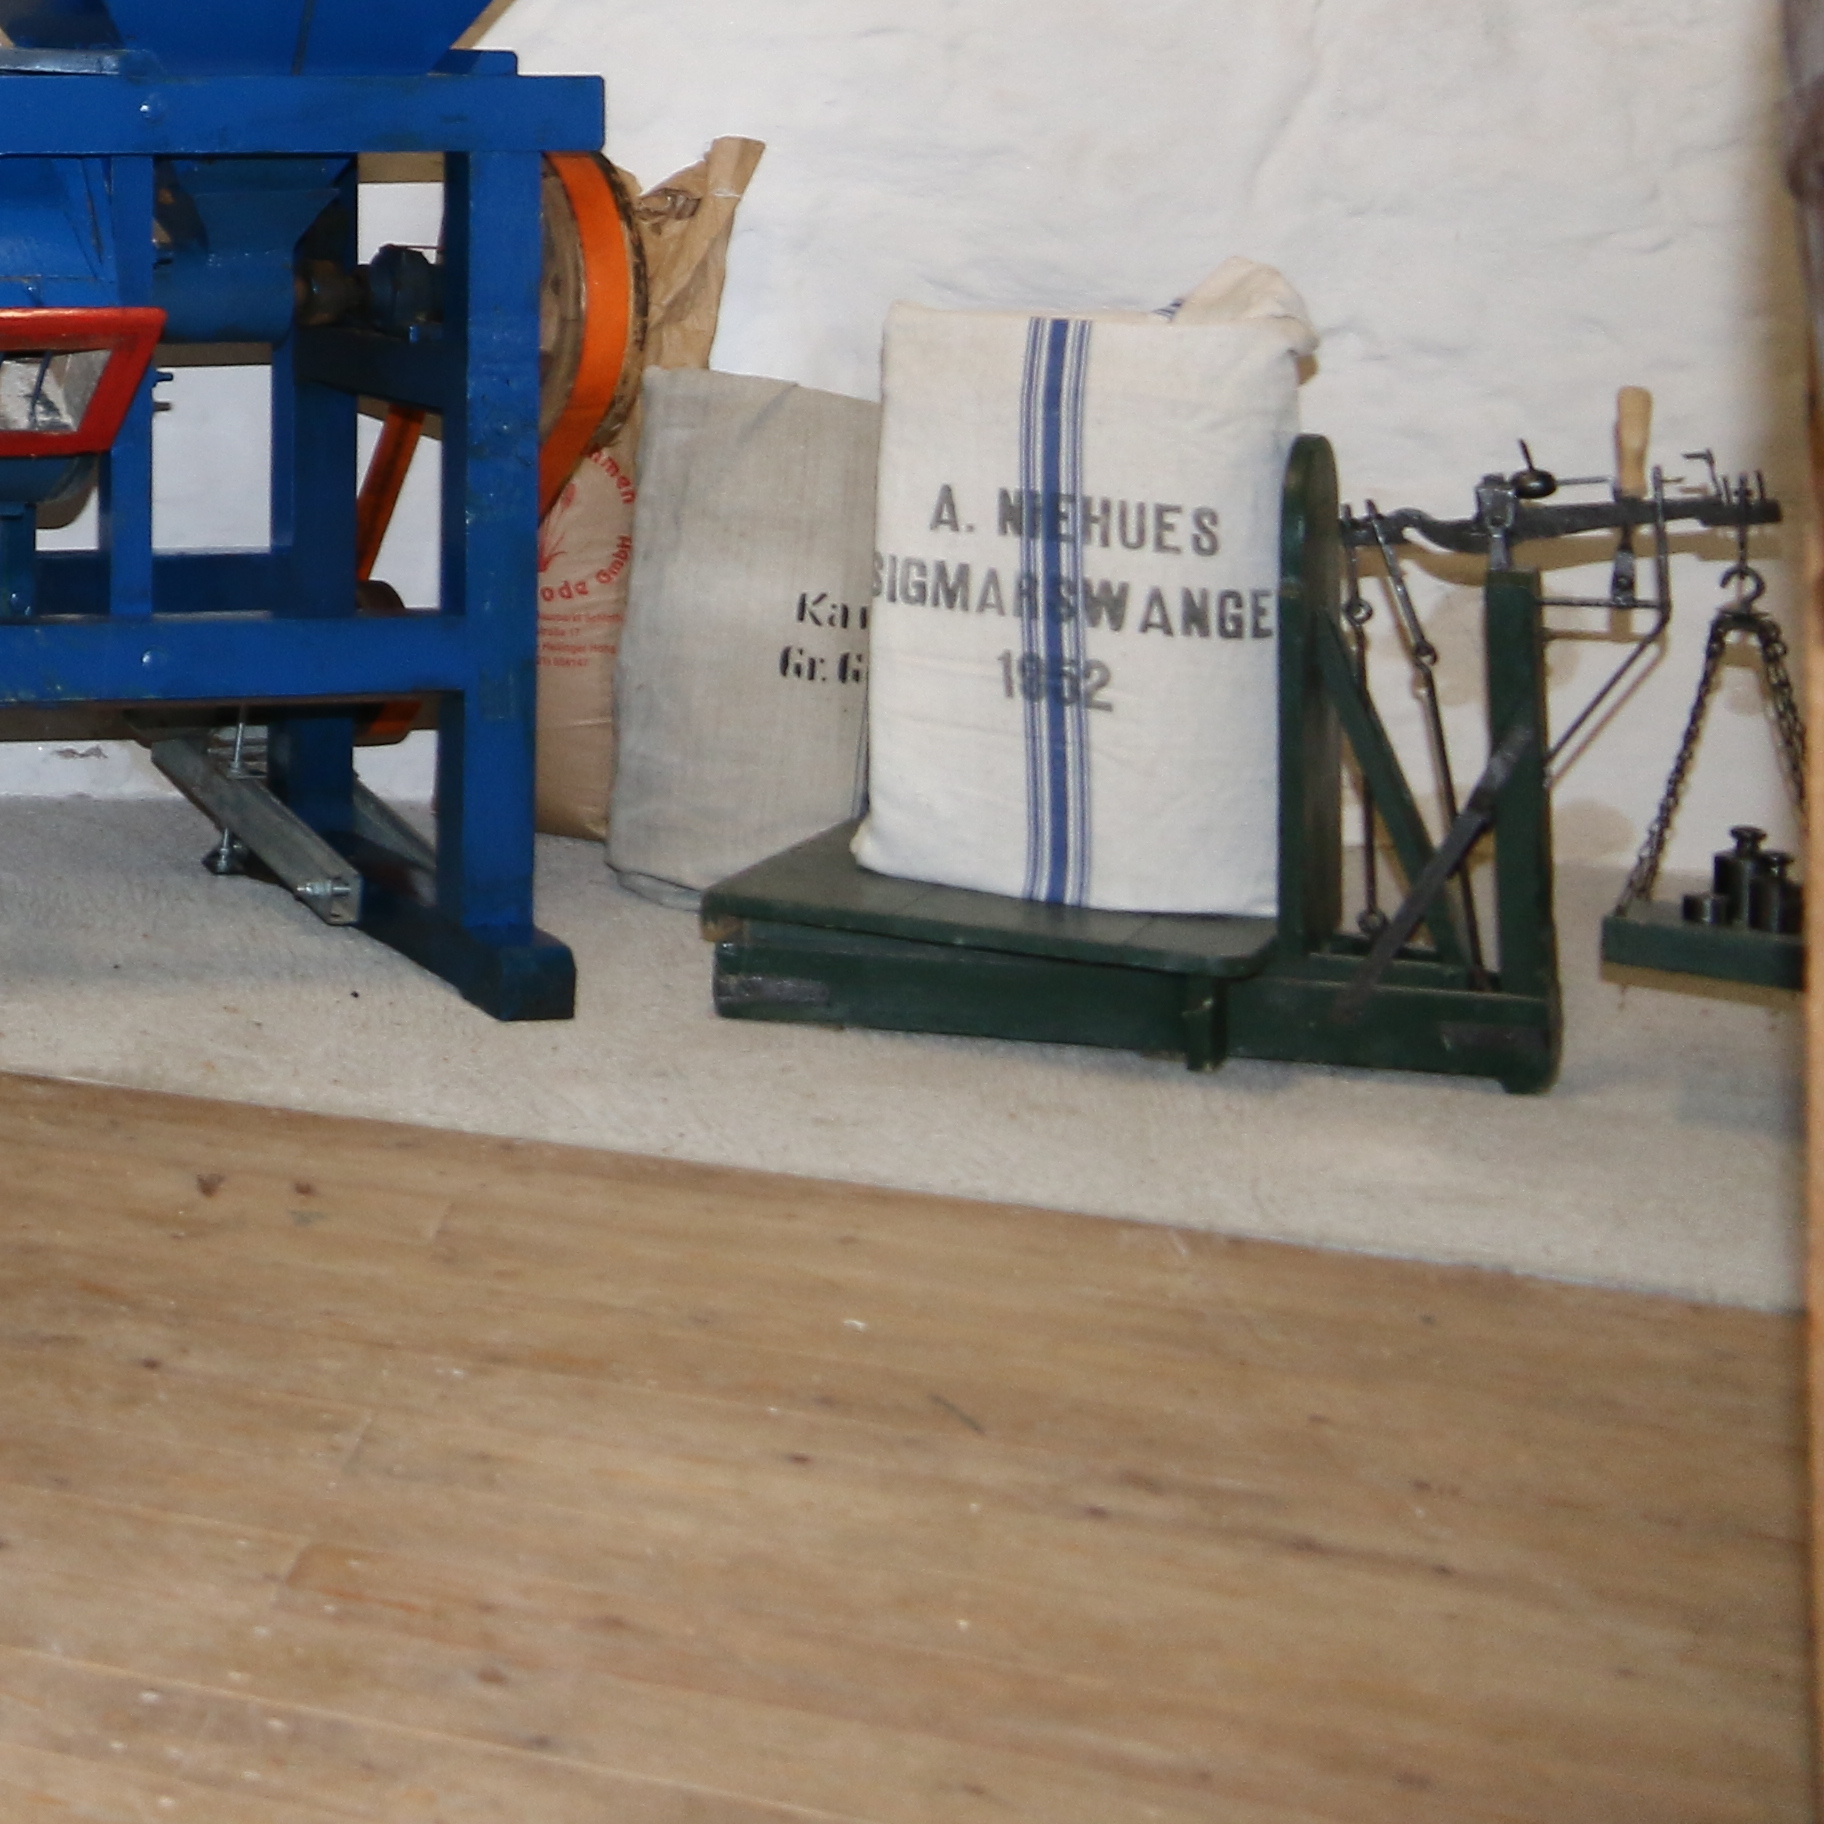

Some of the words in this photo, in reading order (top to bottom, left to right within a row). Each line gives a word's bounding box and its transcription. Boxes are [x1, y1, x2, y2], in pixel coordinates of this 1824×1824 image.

[929, 483, 976, 534] A.
[996, 486, 1221, 557] NIEHUES
[596, 534, 633, 584] GmbH
